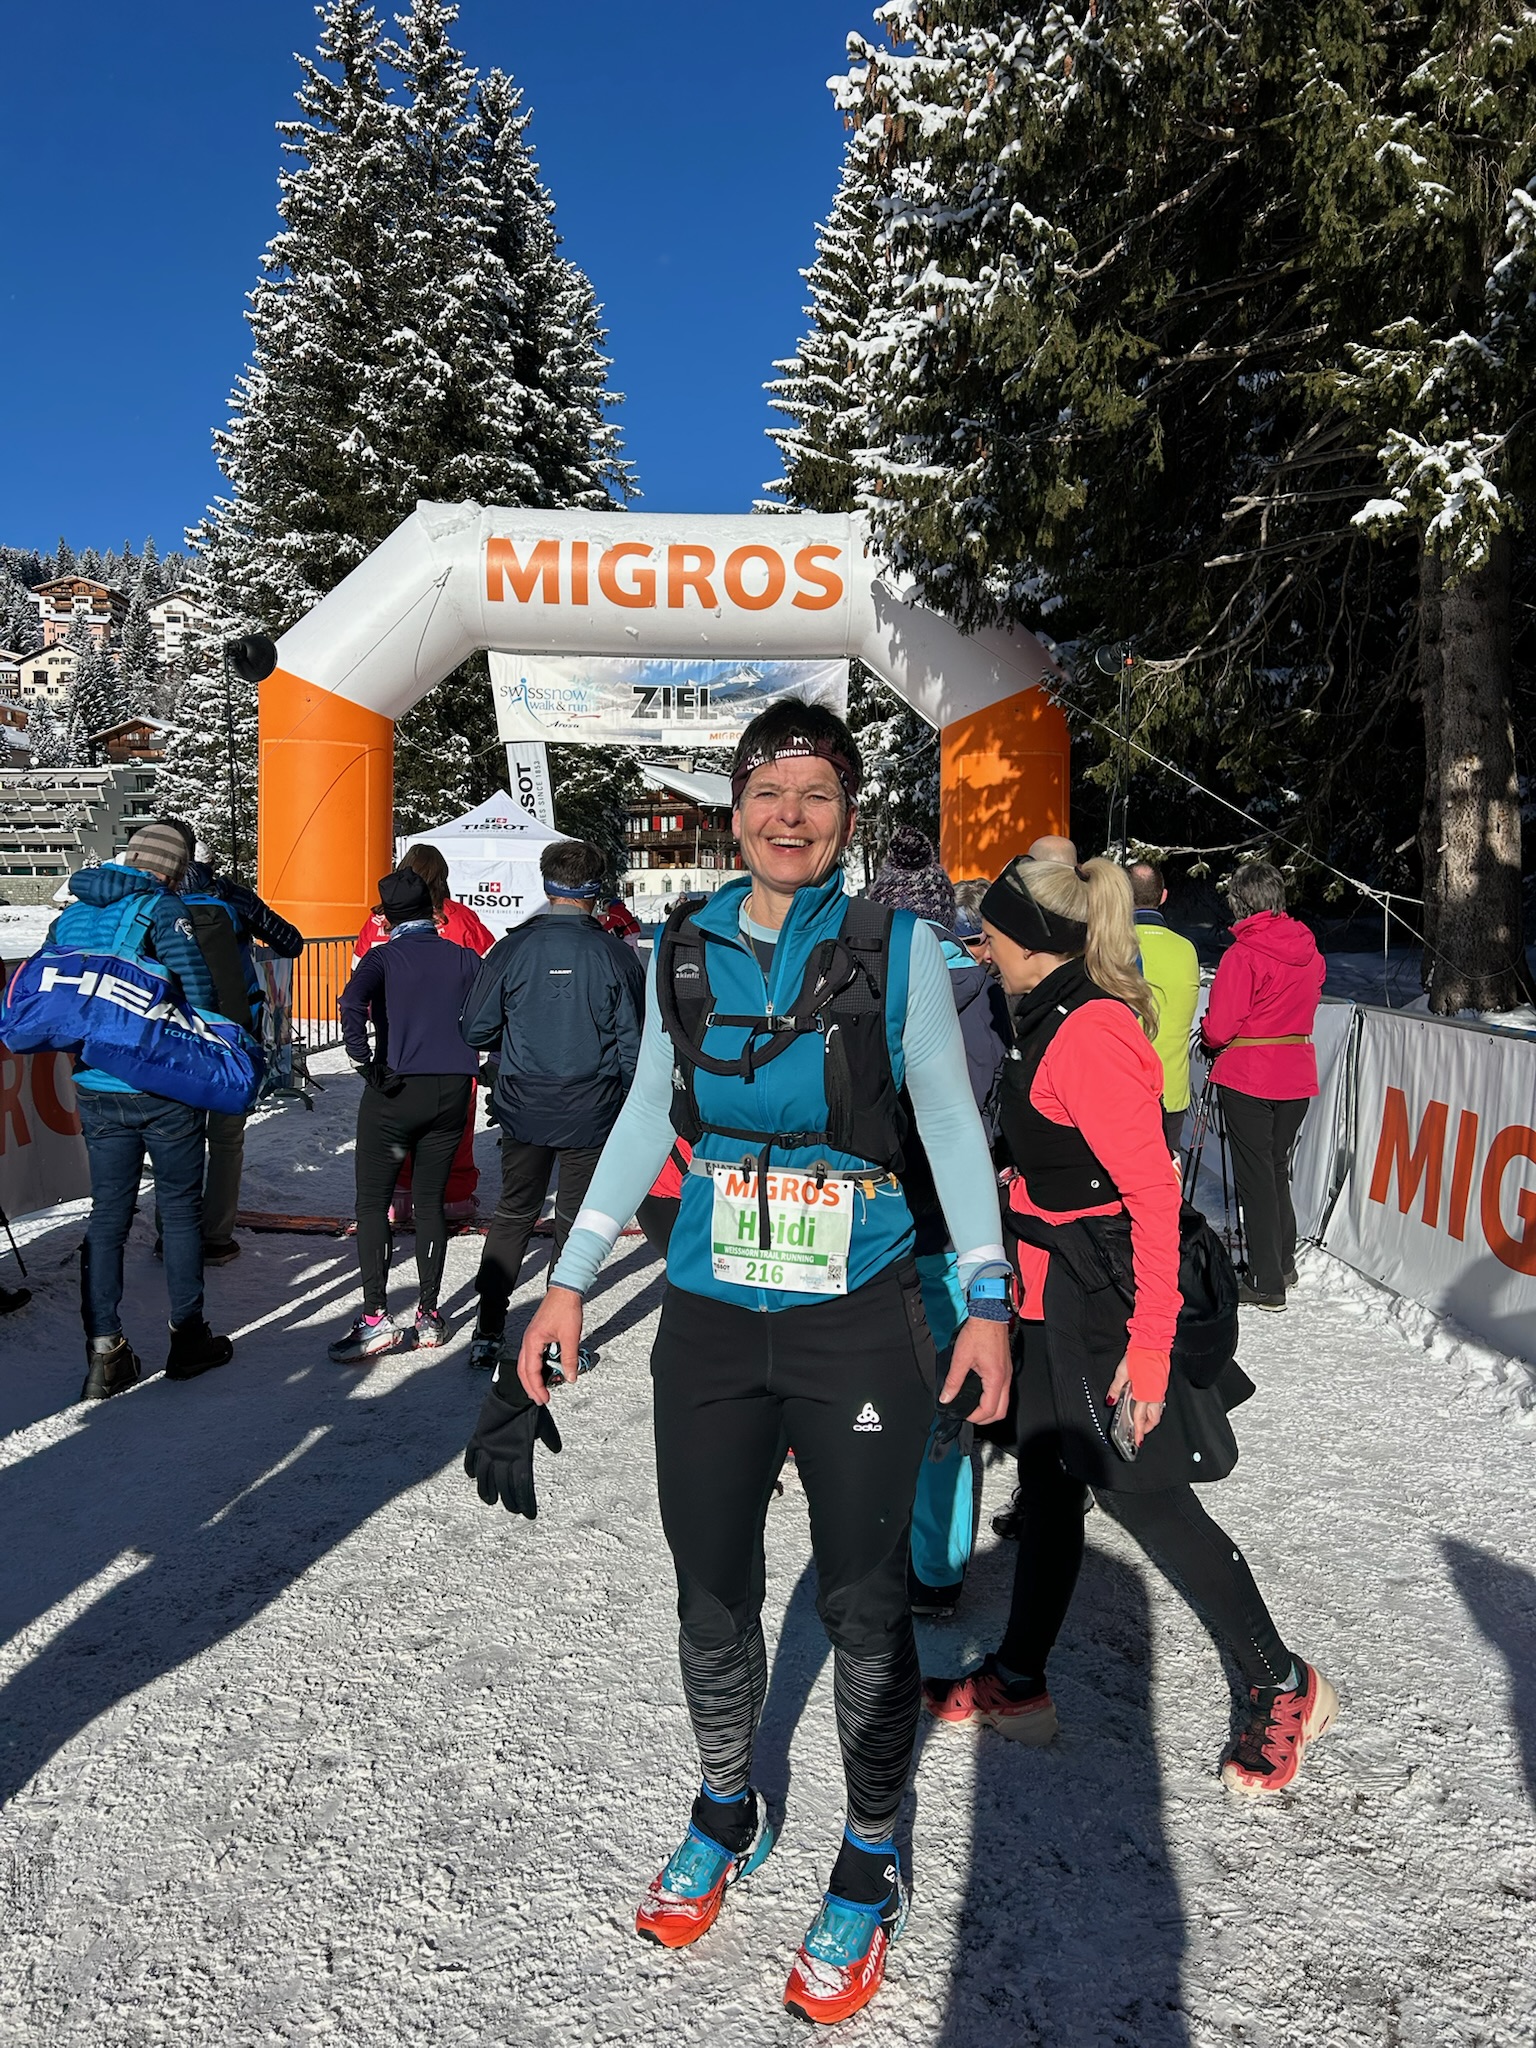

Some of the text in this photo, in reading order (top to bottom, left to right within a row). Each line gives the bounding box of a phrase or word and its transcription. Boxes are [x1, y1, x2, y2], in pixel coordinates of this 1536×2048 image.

[486, 538, 844, 611] MIGROS
[530, 701, 588, 713] walk & run
[630, 685, 719, 720] ZIEL
[546, 720, 580, 728] Arosa
[775, 749, 810, 759] ZINNEN
[534, 761, 542, 778] 1853
[536, 782, 545, 805] SINCE
[455, 894, 524, 907] TISSOT
[164, 1028, 201, 1044] TOUR
[725, 1173, 840, 1207] MIGROS
[1368, 1085, 1536, 1278] MIG
[724, 1245, 815, 1264] WEISSHORN TRAIL RUNNING
[745, 1261, 784, 1285] 216
[852, 1423, 883, 1432] odlo
